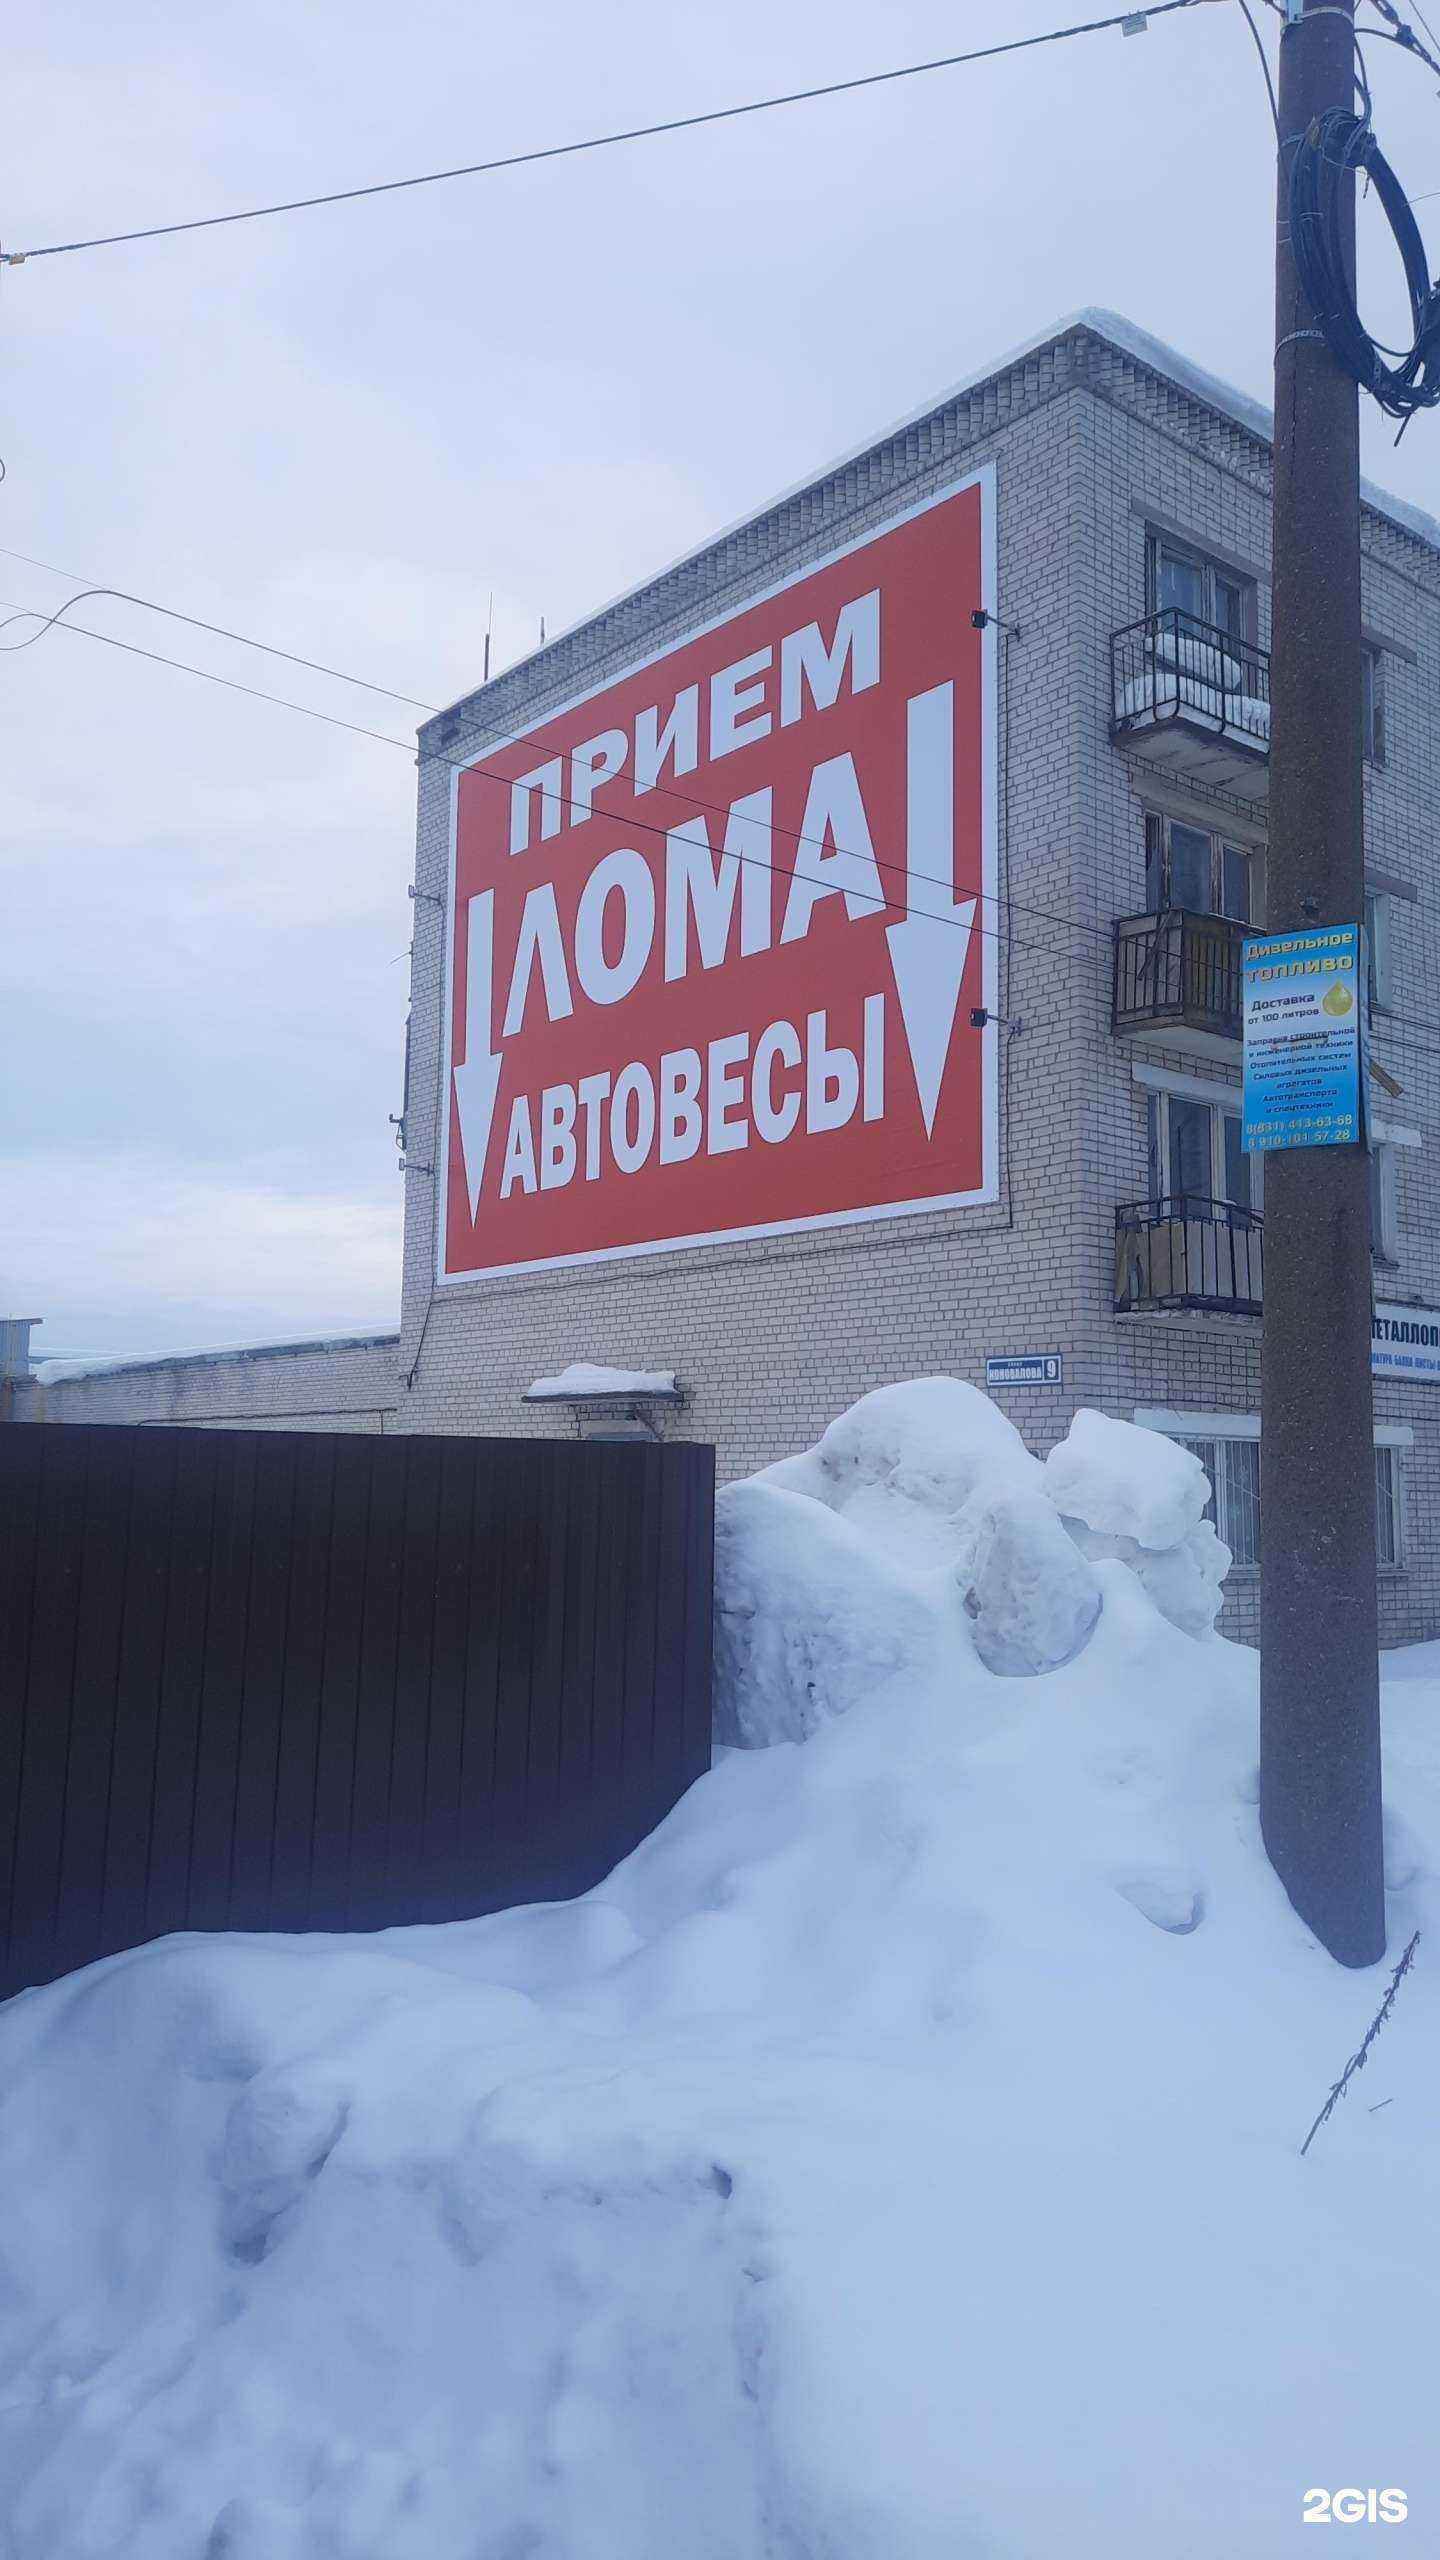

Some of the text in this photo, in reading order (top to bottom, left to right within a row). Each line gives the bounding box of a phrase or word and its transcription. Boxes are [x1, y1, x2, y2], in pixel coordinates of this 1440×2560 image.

[509, 588, 880, 855] ПРИЕМ
[501, 751, 888, 1038] ЛОМА
[1247, 932, 1353, 960] Дизельное
[1248, 1008, 1319, 1024] от 100 литров
[1251, 994, 1315, 1011] Доставка
[499, 992, 886, 1199] АВТОВЕСЫ
[1371, 1318, 1440, 1347] ЕТАЛЛОП
[989, 1367, 1042, 1380] КОНОВАЛОВА
[1046, 1360, 1056, 1378] 9
